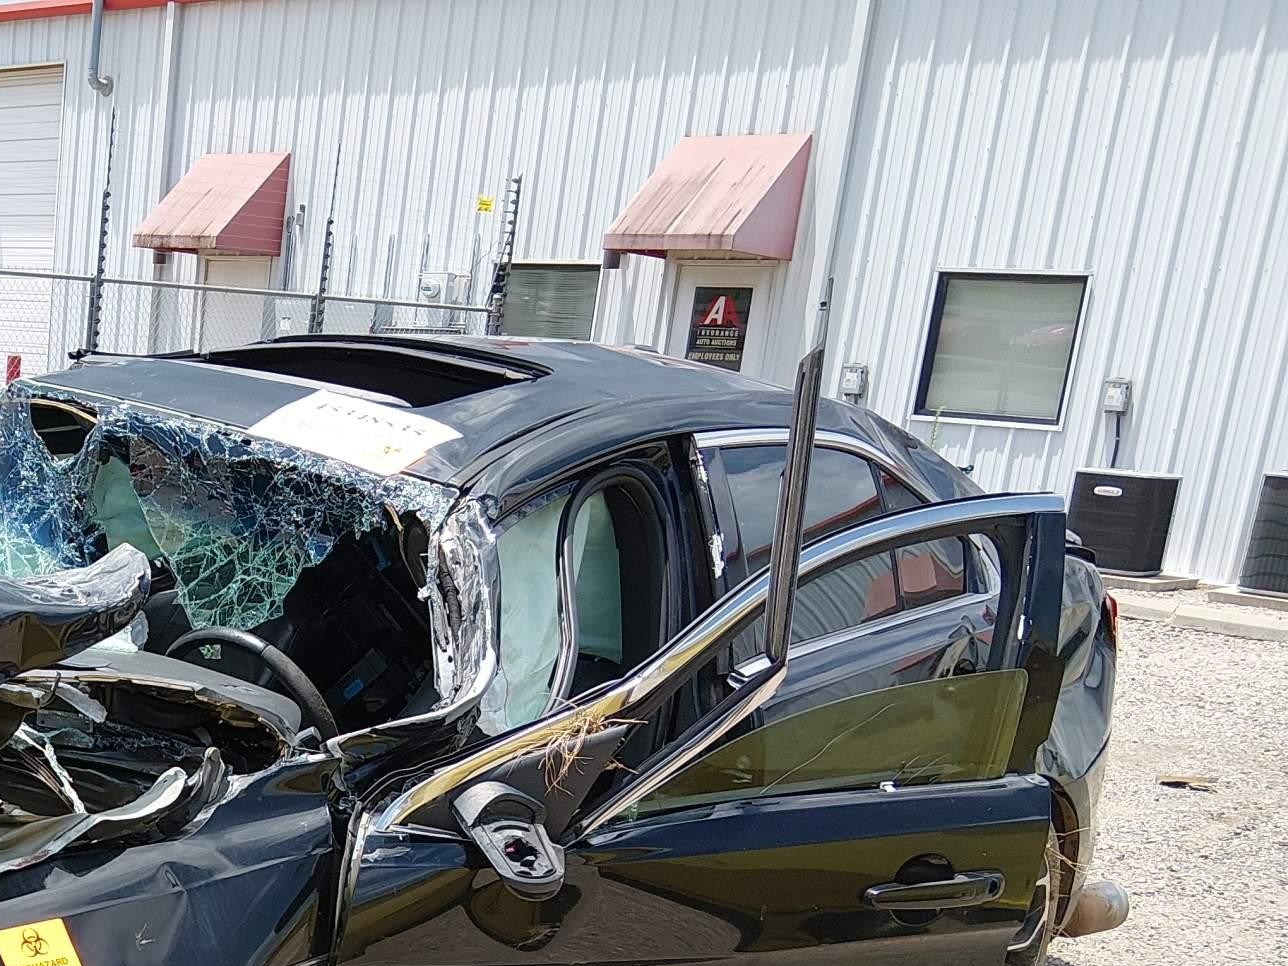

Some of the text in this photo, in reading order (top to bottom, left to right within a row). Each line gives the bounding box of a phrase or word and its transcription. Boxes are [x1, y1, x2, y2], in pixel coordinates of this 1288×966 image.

[696, 338, 737, 347] AUTO AUCTIONS
[688, 351, 740, 361] EMPLOYEES ONLY
